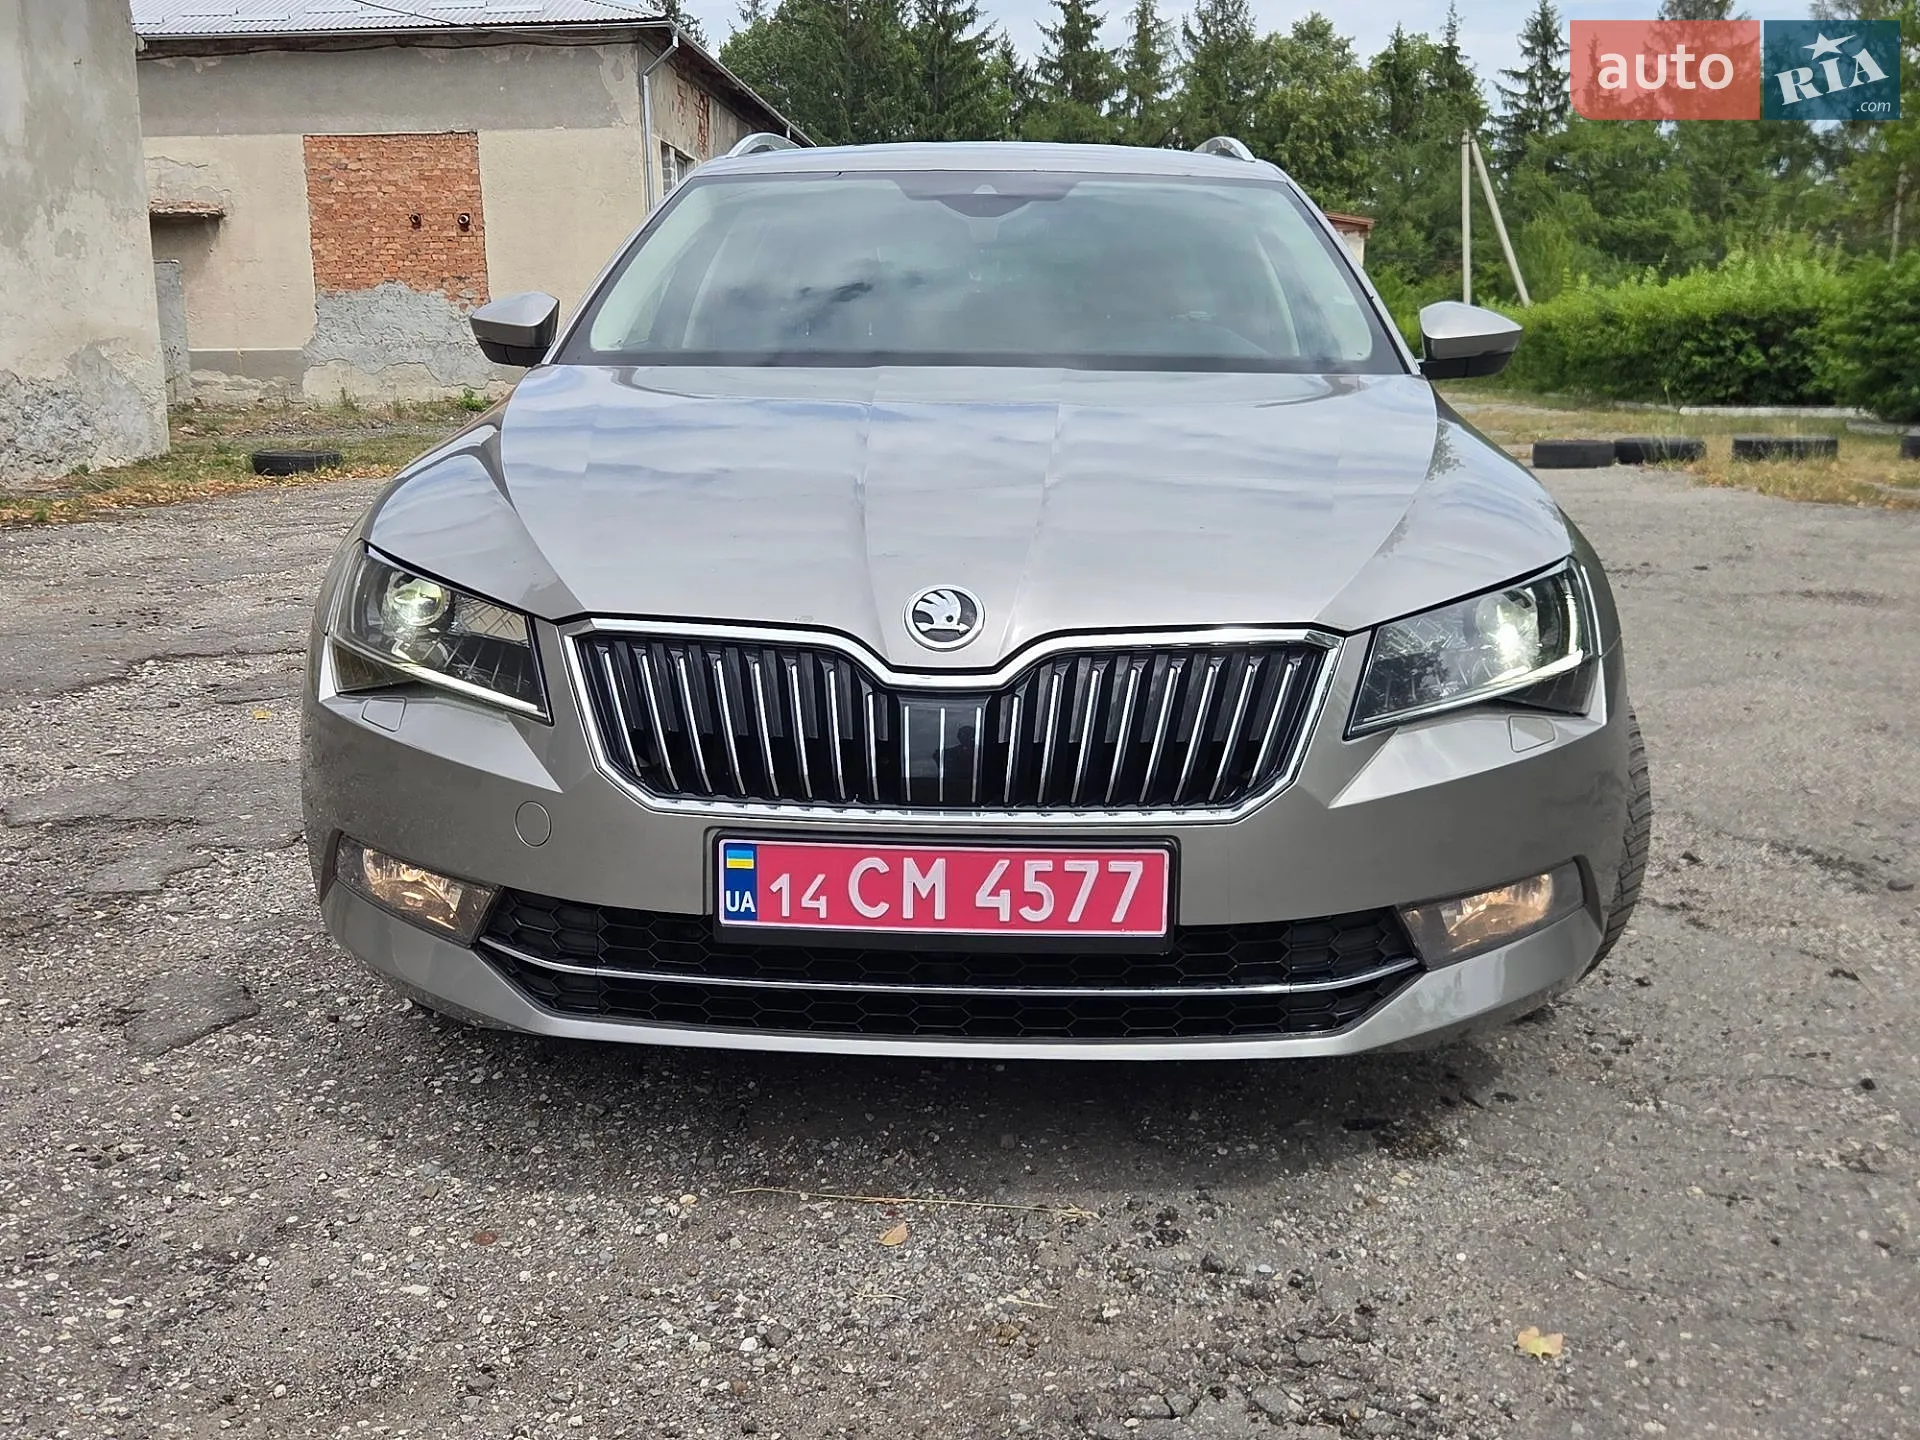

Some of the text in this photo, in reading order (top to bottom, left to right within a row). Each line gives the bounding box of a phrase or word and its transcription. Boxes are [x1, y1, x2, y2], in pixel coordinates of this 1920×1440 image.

[726, 890, 756, 913] UA
[769, 857, 1144, 923] 14 CM 4577
